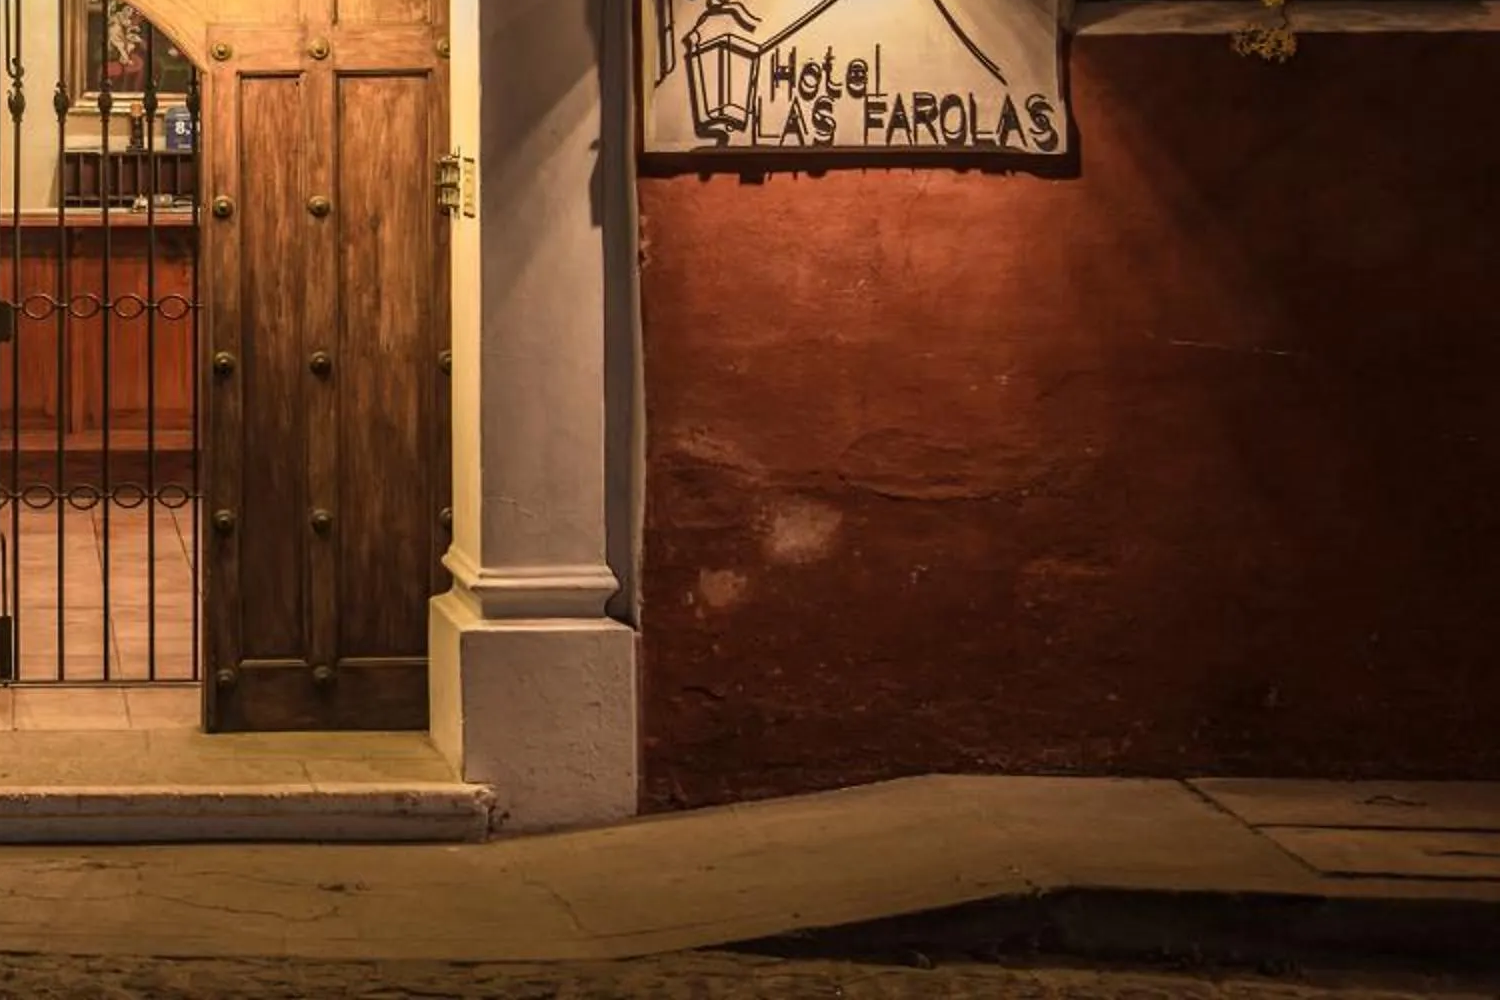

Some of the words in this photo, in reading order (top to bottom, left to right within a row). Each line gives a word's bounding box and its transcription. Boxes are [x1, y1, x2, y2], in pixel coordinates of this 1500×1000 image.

[770, 42, 881, 101] Hotel
[753, 94, 837, 147] LAS
[862, 90, 1059, 152] FAROLAS
